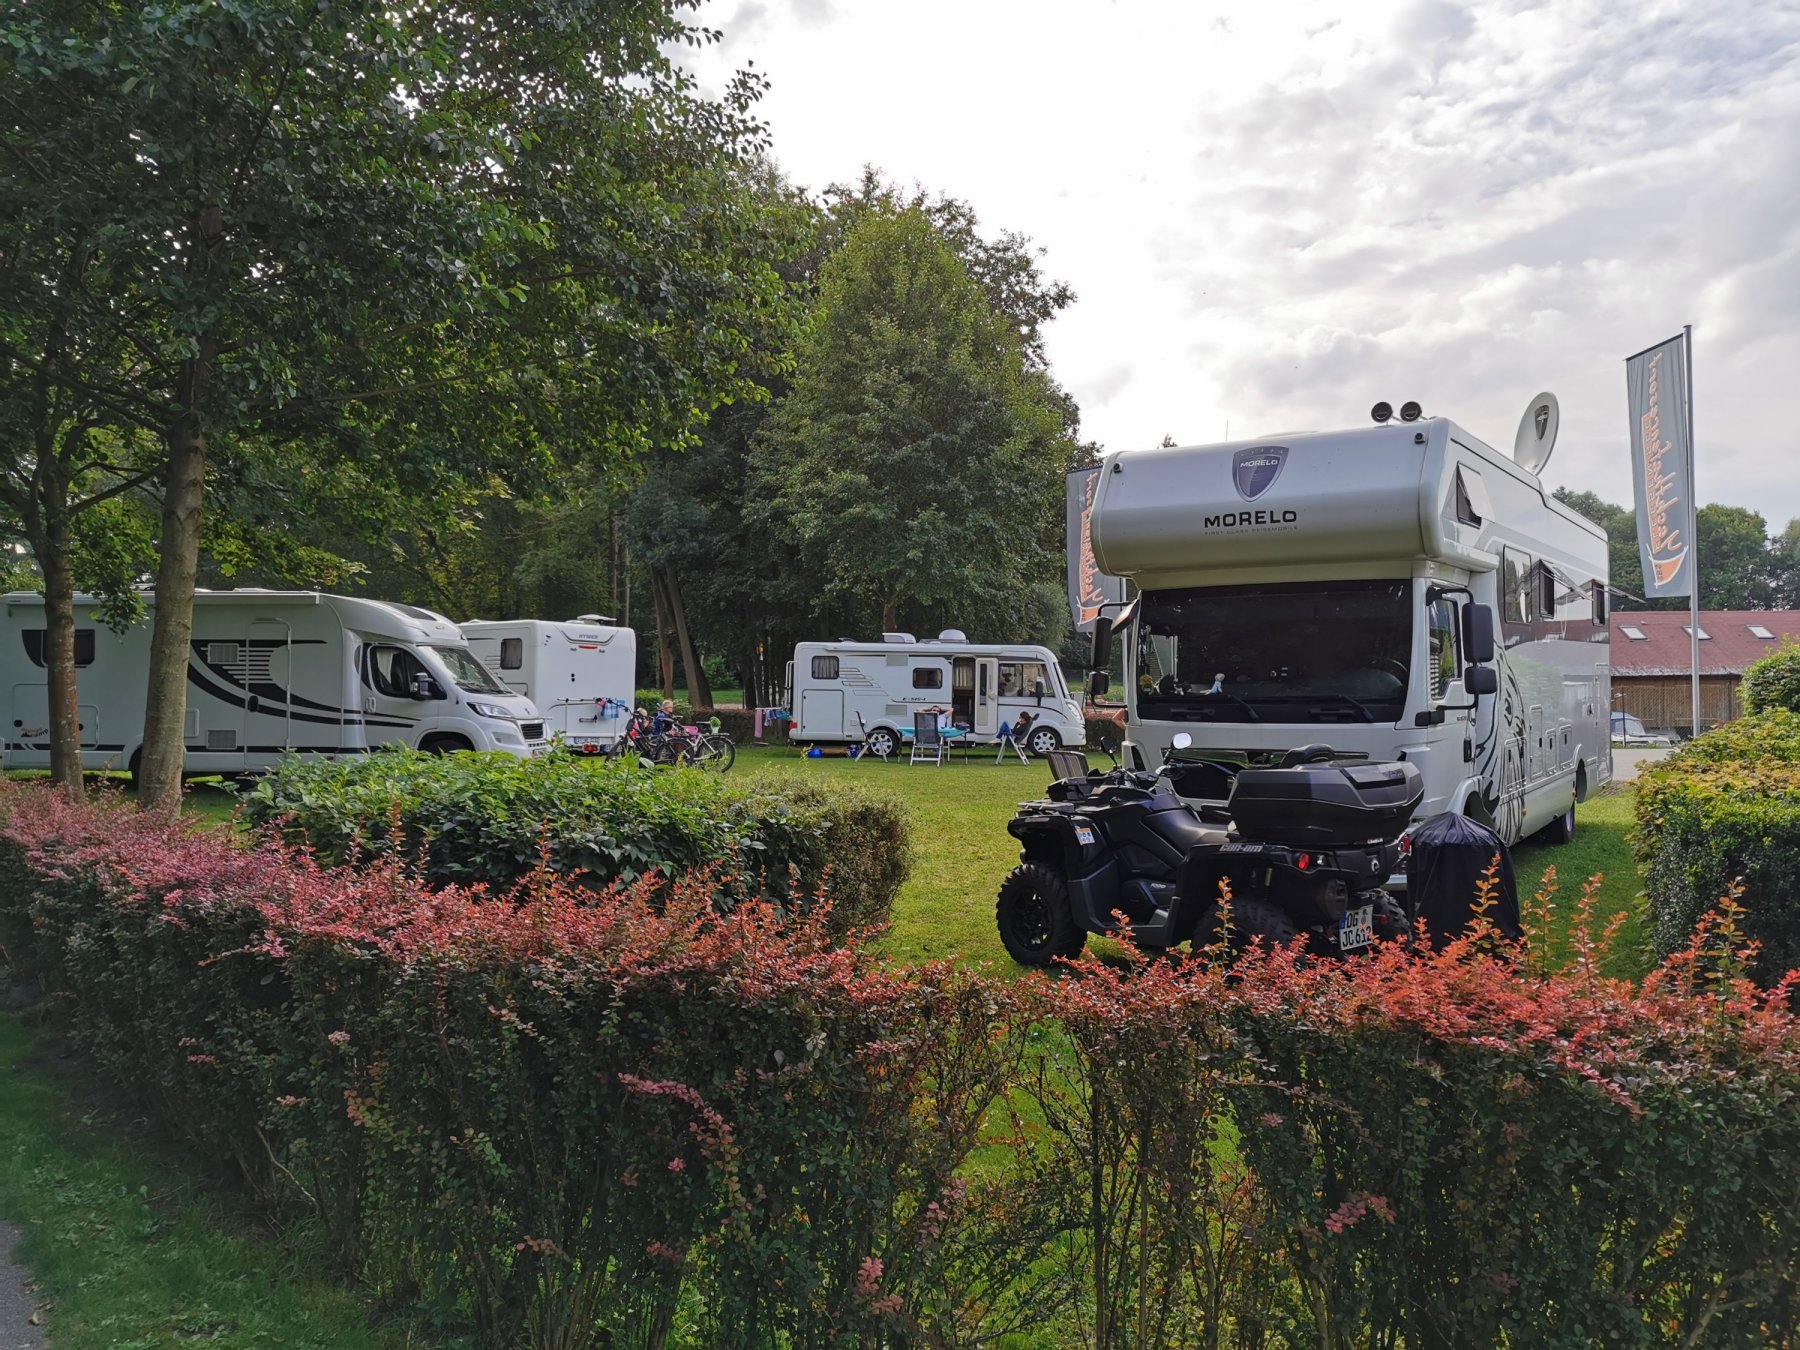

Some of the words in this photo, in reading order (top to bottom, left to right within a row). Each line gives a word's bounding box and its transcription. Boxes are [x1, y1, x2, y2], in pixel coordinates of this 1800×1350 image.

[1240, 459, 1278, 468] MORELO
[1204, 510, 1297, 528] MORELO
[1346, 911, 1359, 929] OG
[1342, 929, 1353, 947] JC
